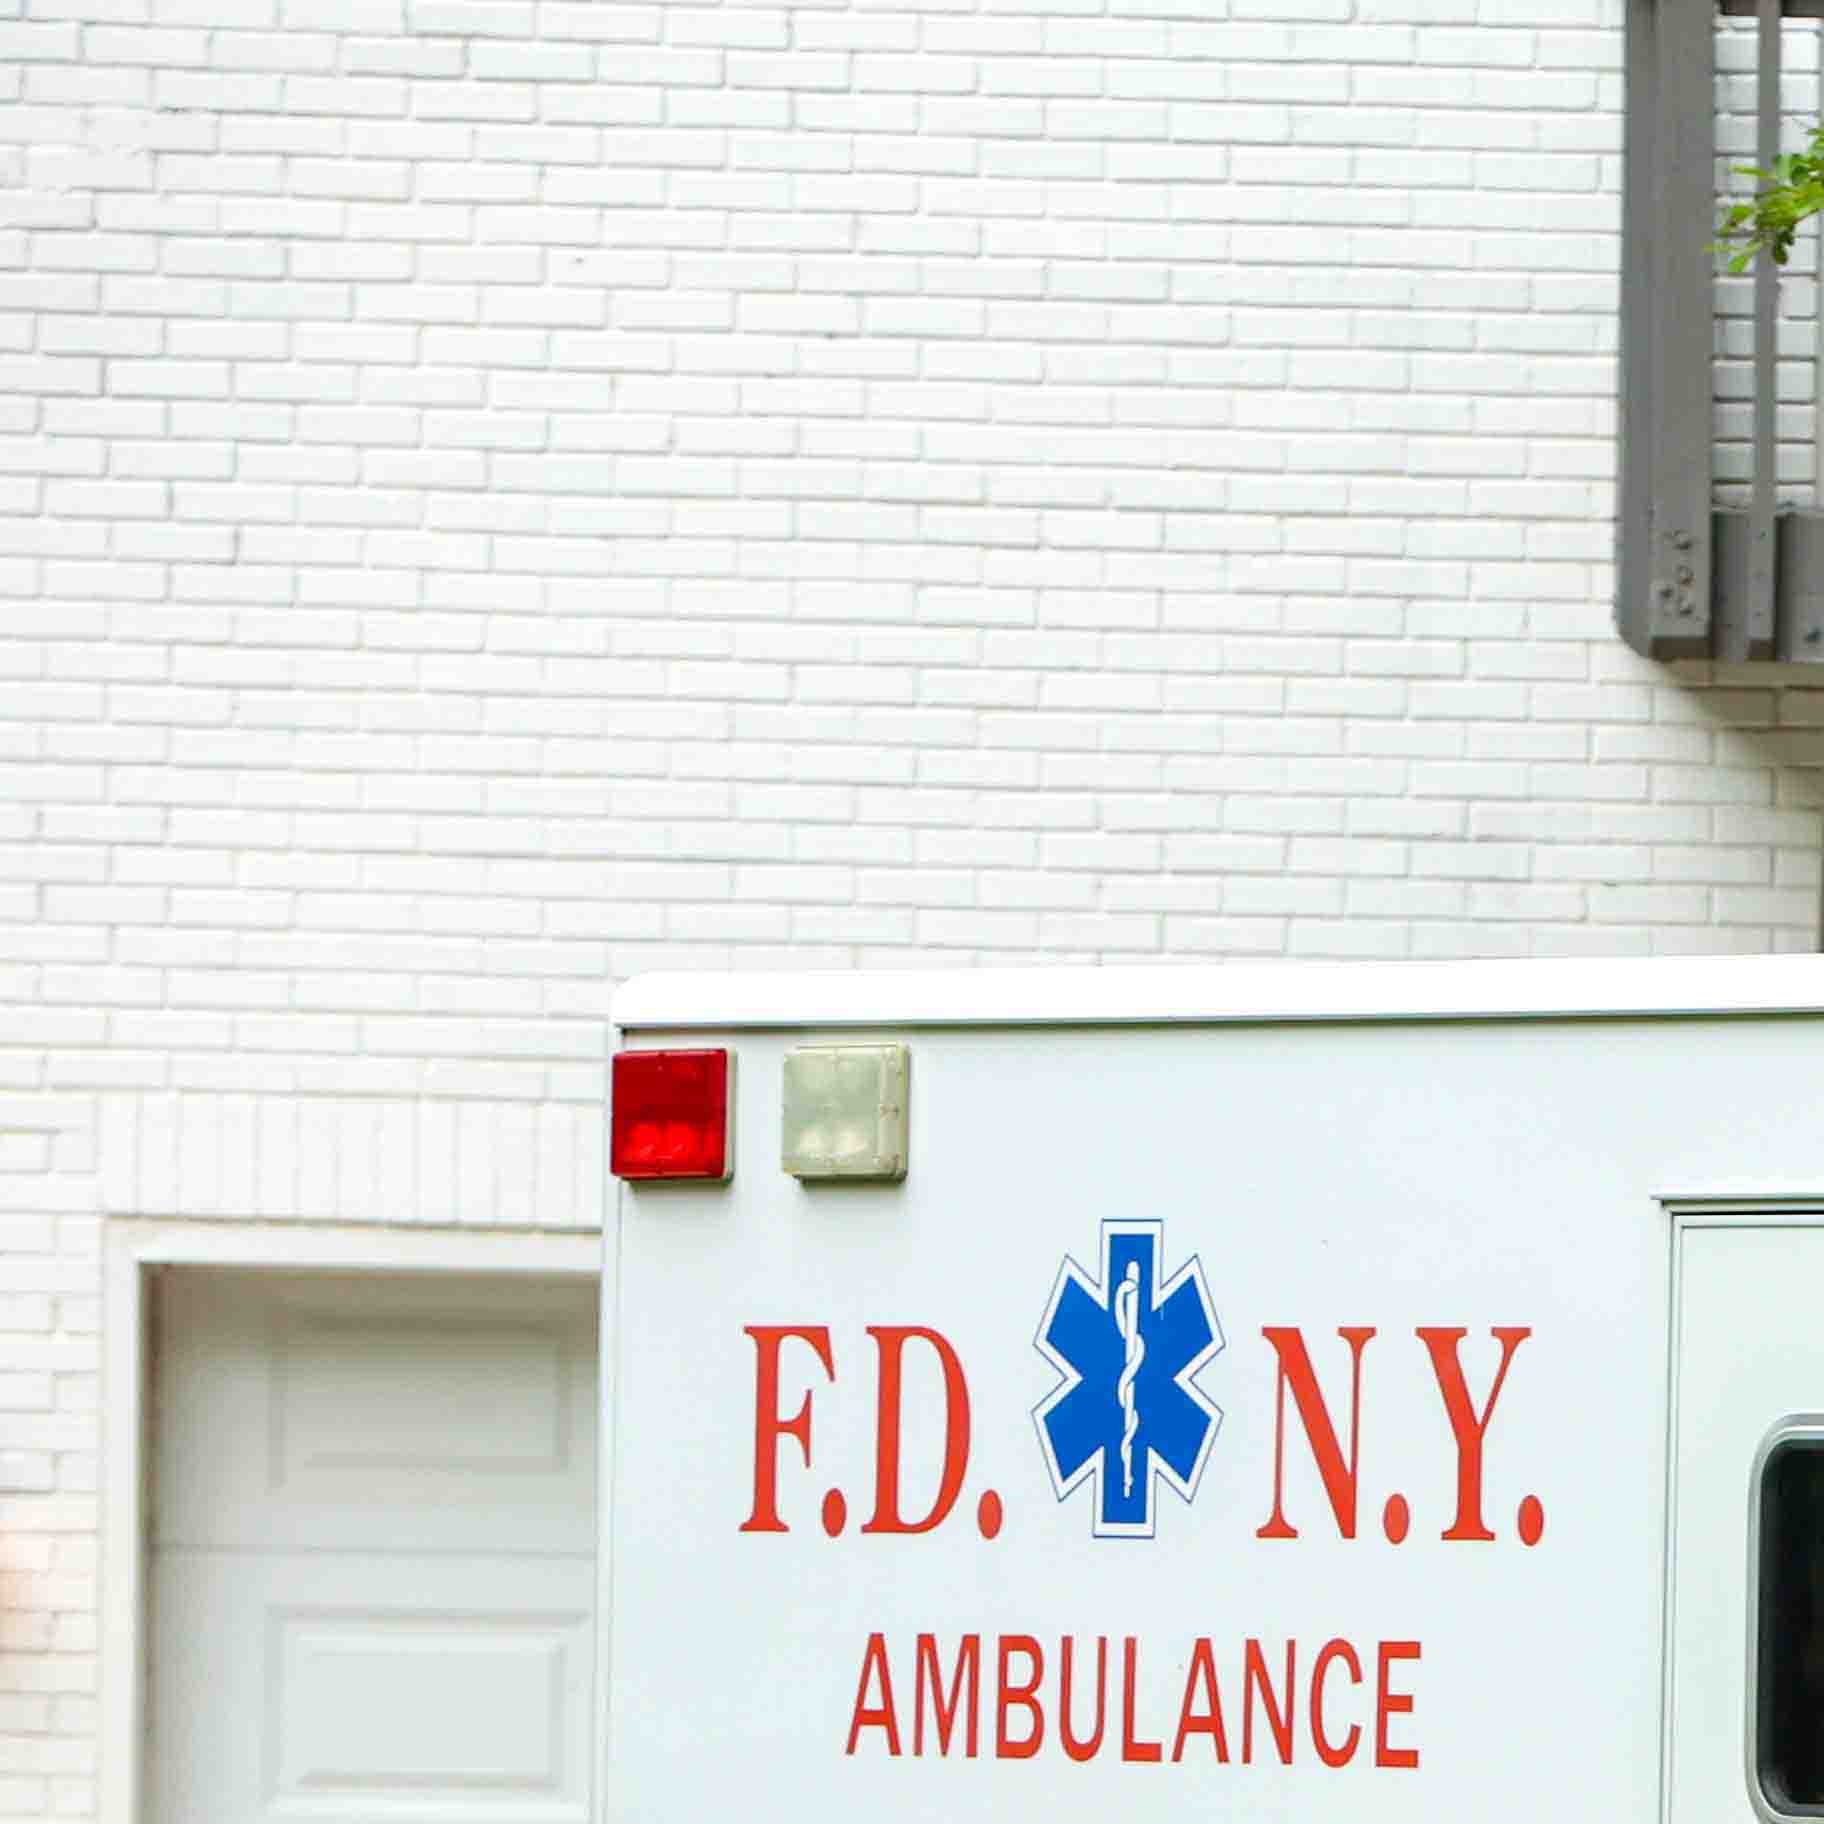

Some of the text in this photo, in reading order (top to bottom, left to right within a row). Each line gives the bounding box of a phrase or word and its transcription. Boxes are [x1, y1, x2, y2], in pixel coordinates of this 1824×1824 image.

[739, 1326, 1544, 1546] F.D. N.Y.
[846, 1633, 1420, 1768] AMBULANCE
